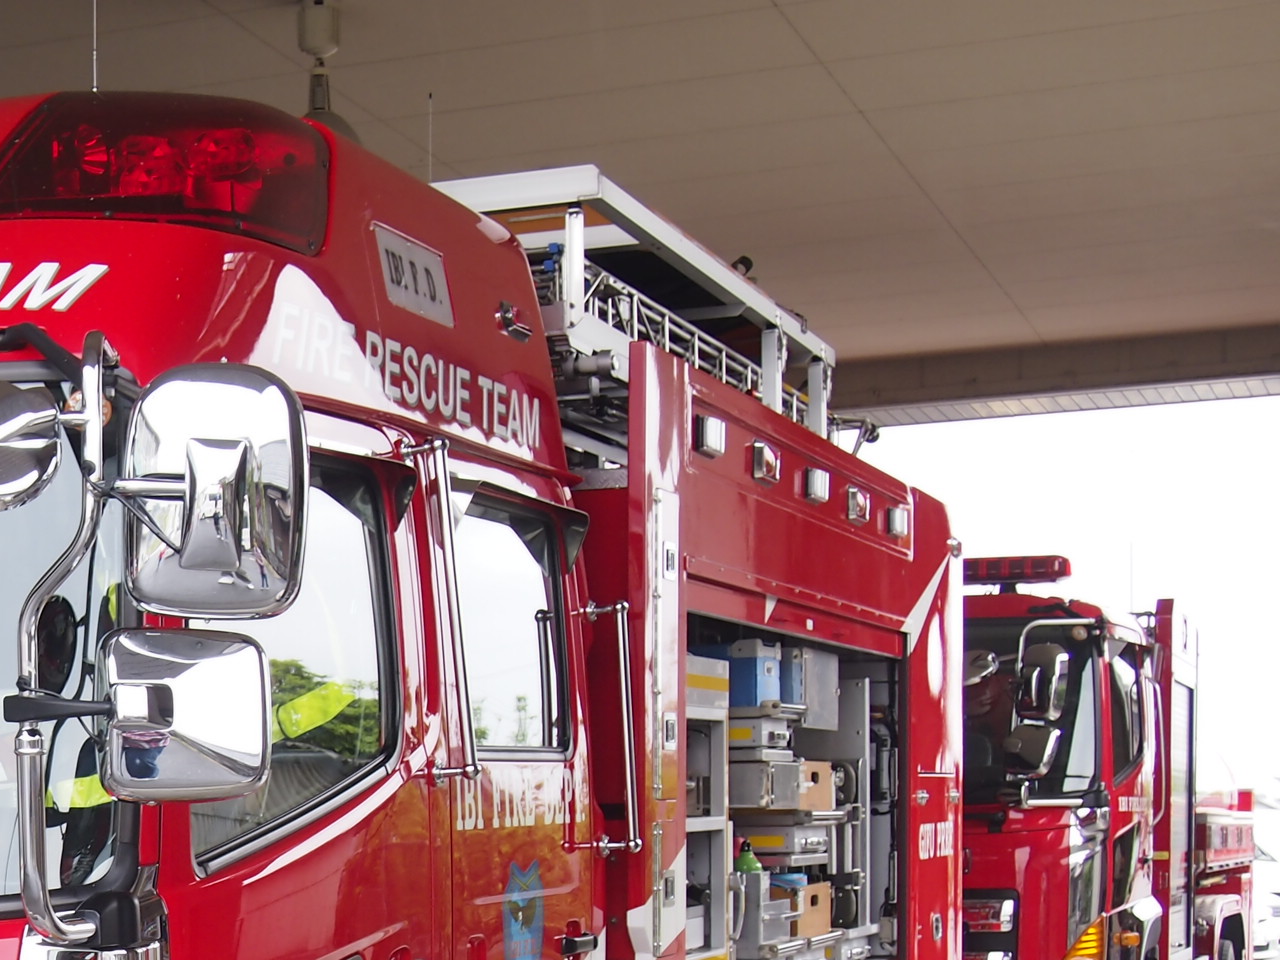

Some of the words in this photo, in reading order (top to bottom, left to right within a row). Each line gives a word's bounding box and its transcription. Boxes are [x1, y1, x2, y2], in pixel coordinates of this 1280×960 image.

[271, 302, 356, 384] FIRE
[365, 330, 472, 427] RESCUE
[478, 374, 540, 450] TEAM
